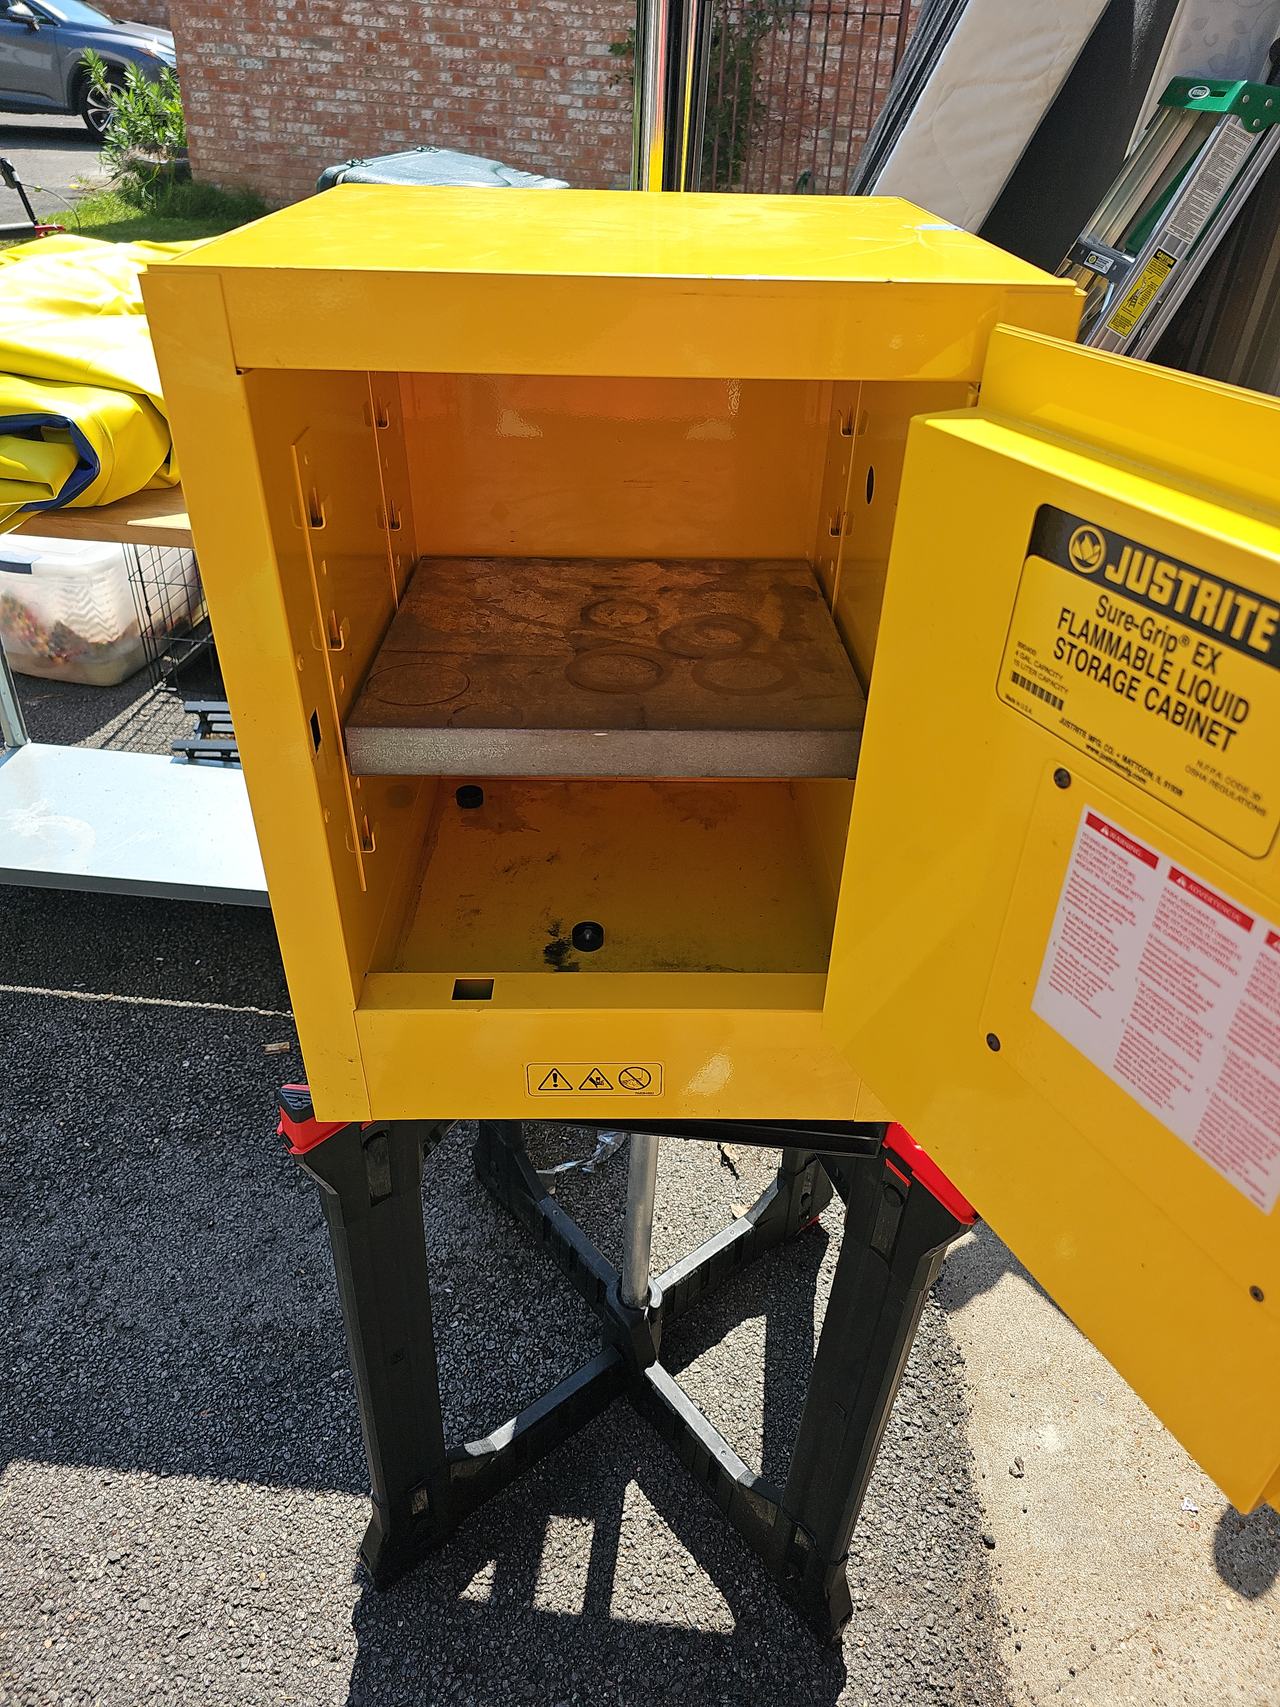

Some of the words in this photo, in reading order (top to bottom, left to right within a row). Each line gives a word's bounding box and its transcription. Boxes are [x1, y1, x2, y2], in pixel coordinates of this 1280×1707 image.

[1104, 546, 1279, 653] JUSTRITE
[1034, 660, 1063, 680] CAPACITY
[1057, 607, 1173, 685] FLAMMABLE
[1175, 668, 1250, 724] LIQUID
[1192, 641, 1222, 675] EX
[1021, 662, 1037, 676] LITER
[1038, 673, 1068, 693] CAPACITY
[1054, 637, 1141, 702] STORAGE
[1144, 687, 1238, 752] CABINET
[1059, 718, 1087, 738] JUSTRITE
[1184, 764, 1207, 782] OSHA
[1209, 778, 1267, 817] REGULATIONS
[1224, 776, 1249, 794] CODE
[1109, 831, 1141, 856] WARNING
